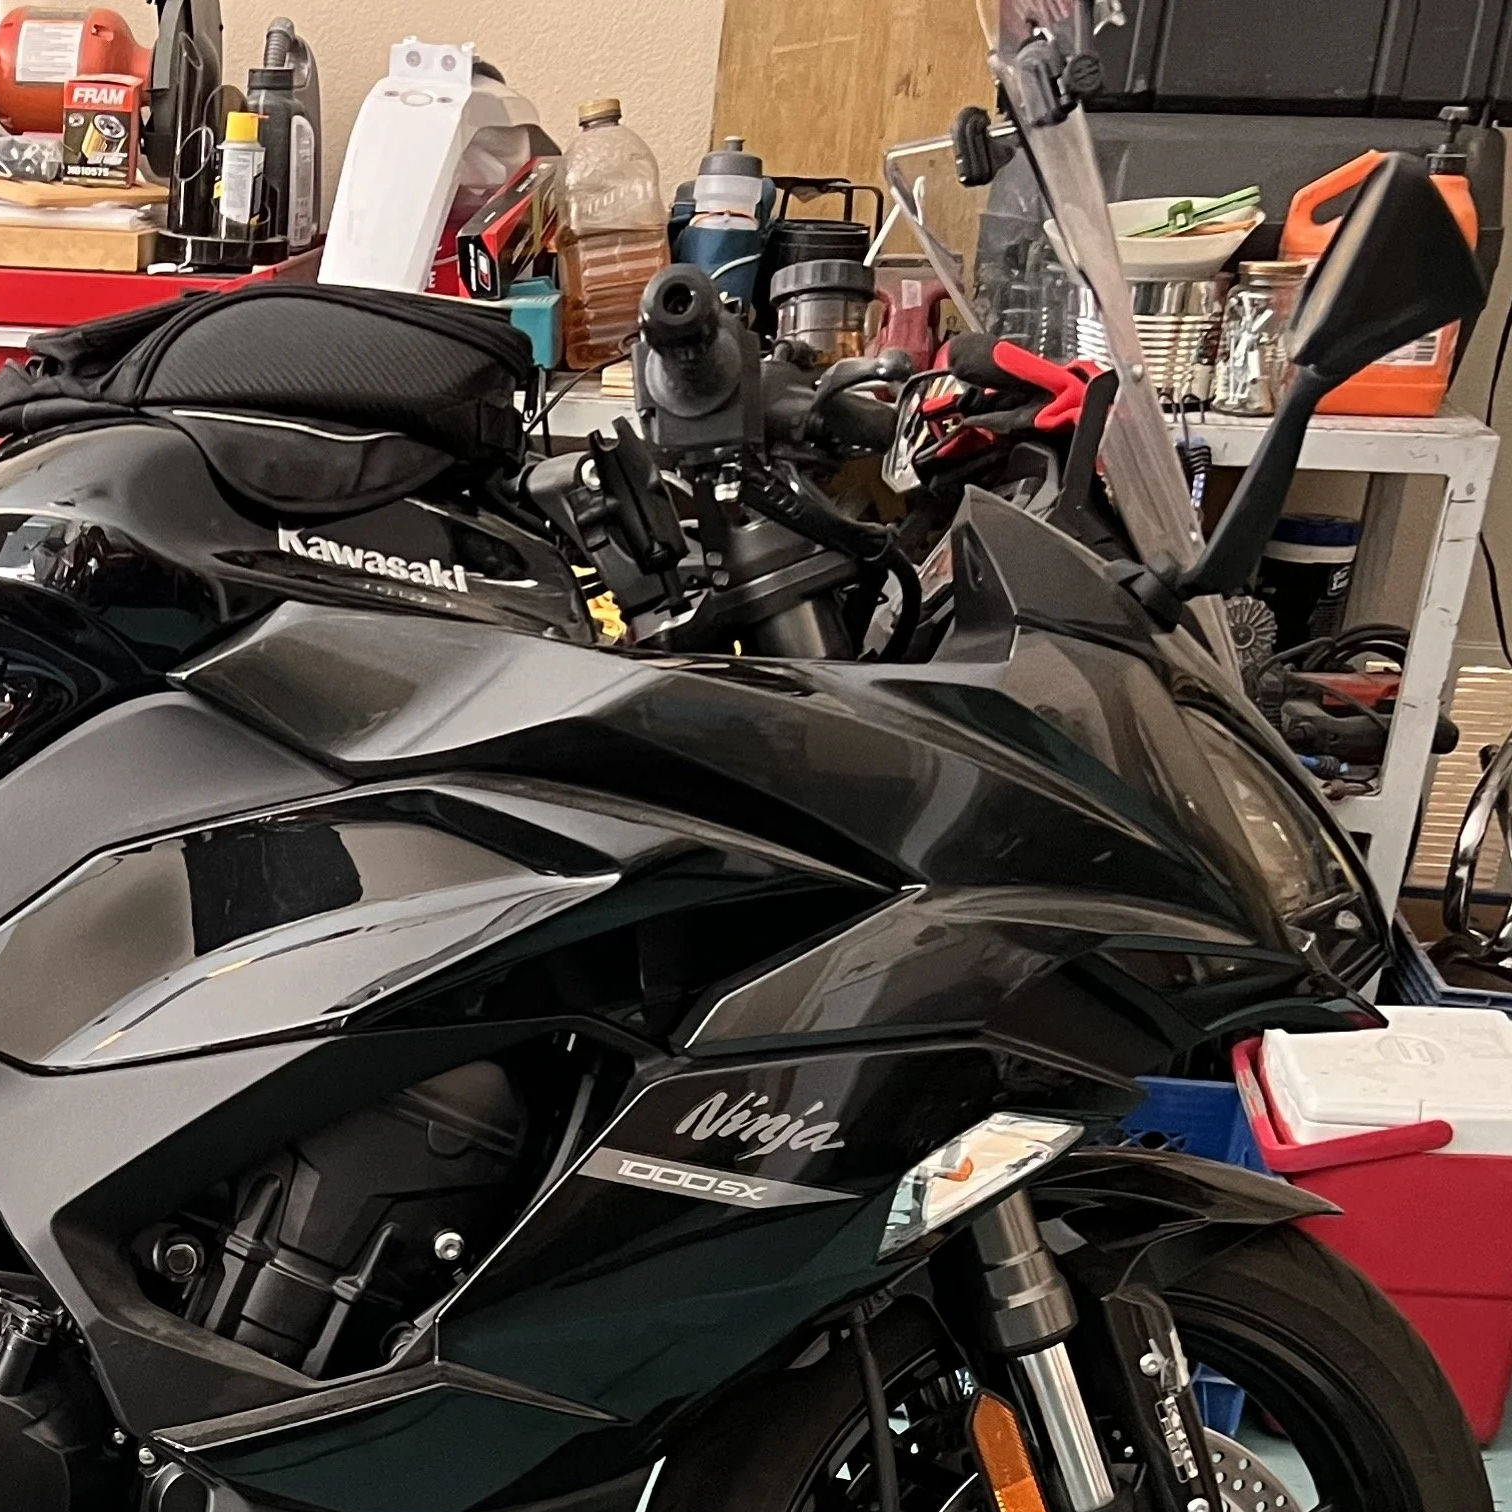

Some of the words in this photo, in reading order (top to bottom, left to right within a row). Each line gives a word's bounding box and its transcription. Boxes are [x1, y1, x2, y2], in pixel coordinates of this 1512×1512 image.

[72, 87, 127, 105] FRAM
[278, 526, 469, 593] Kawasaki
[675, 1091, 845, 1161] Ninja
[617, 1159, 768, 1201] 1000SX
